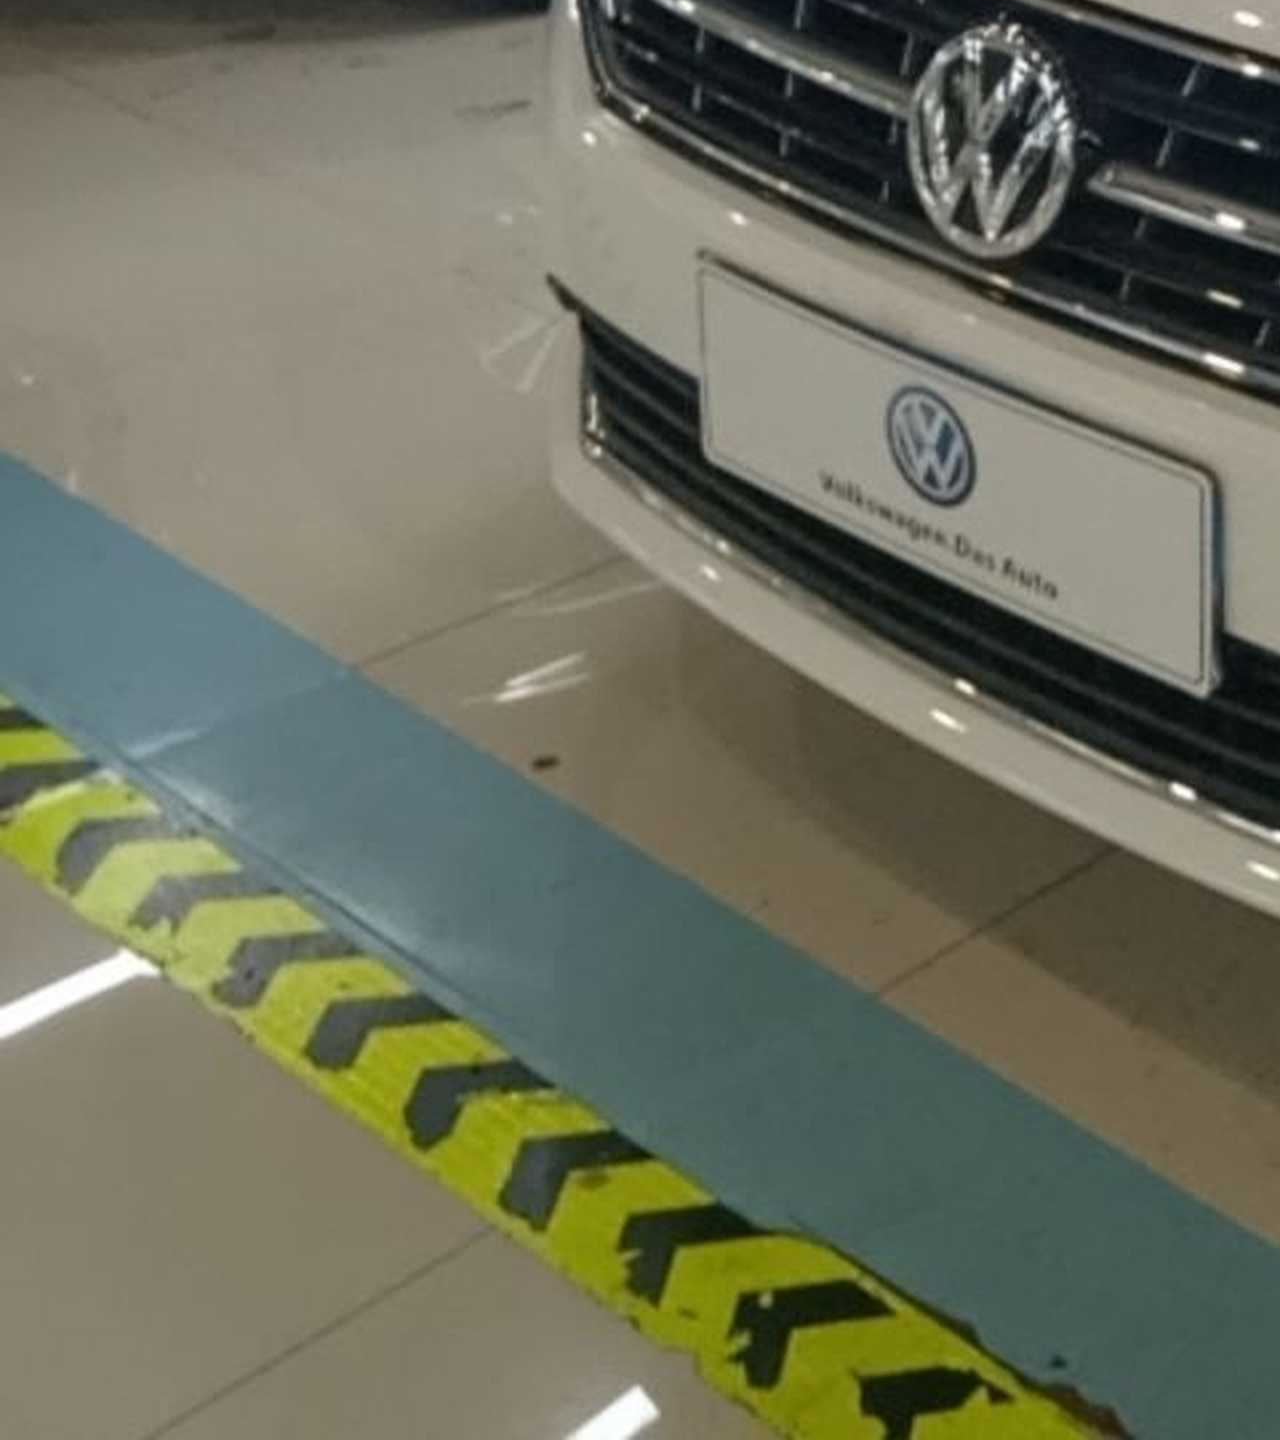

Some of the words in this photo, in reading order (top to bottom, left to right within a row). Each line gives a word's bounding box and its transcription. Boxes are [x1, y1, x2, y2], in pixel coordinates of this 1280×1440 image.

[912, 26, 1073, 255] VW
[889, 389, 974, 505] VW
[955, 533, 997, 573] Das
[1002, 557, 1059, 599] Auto
